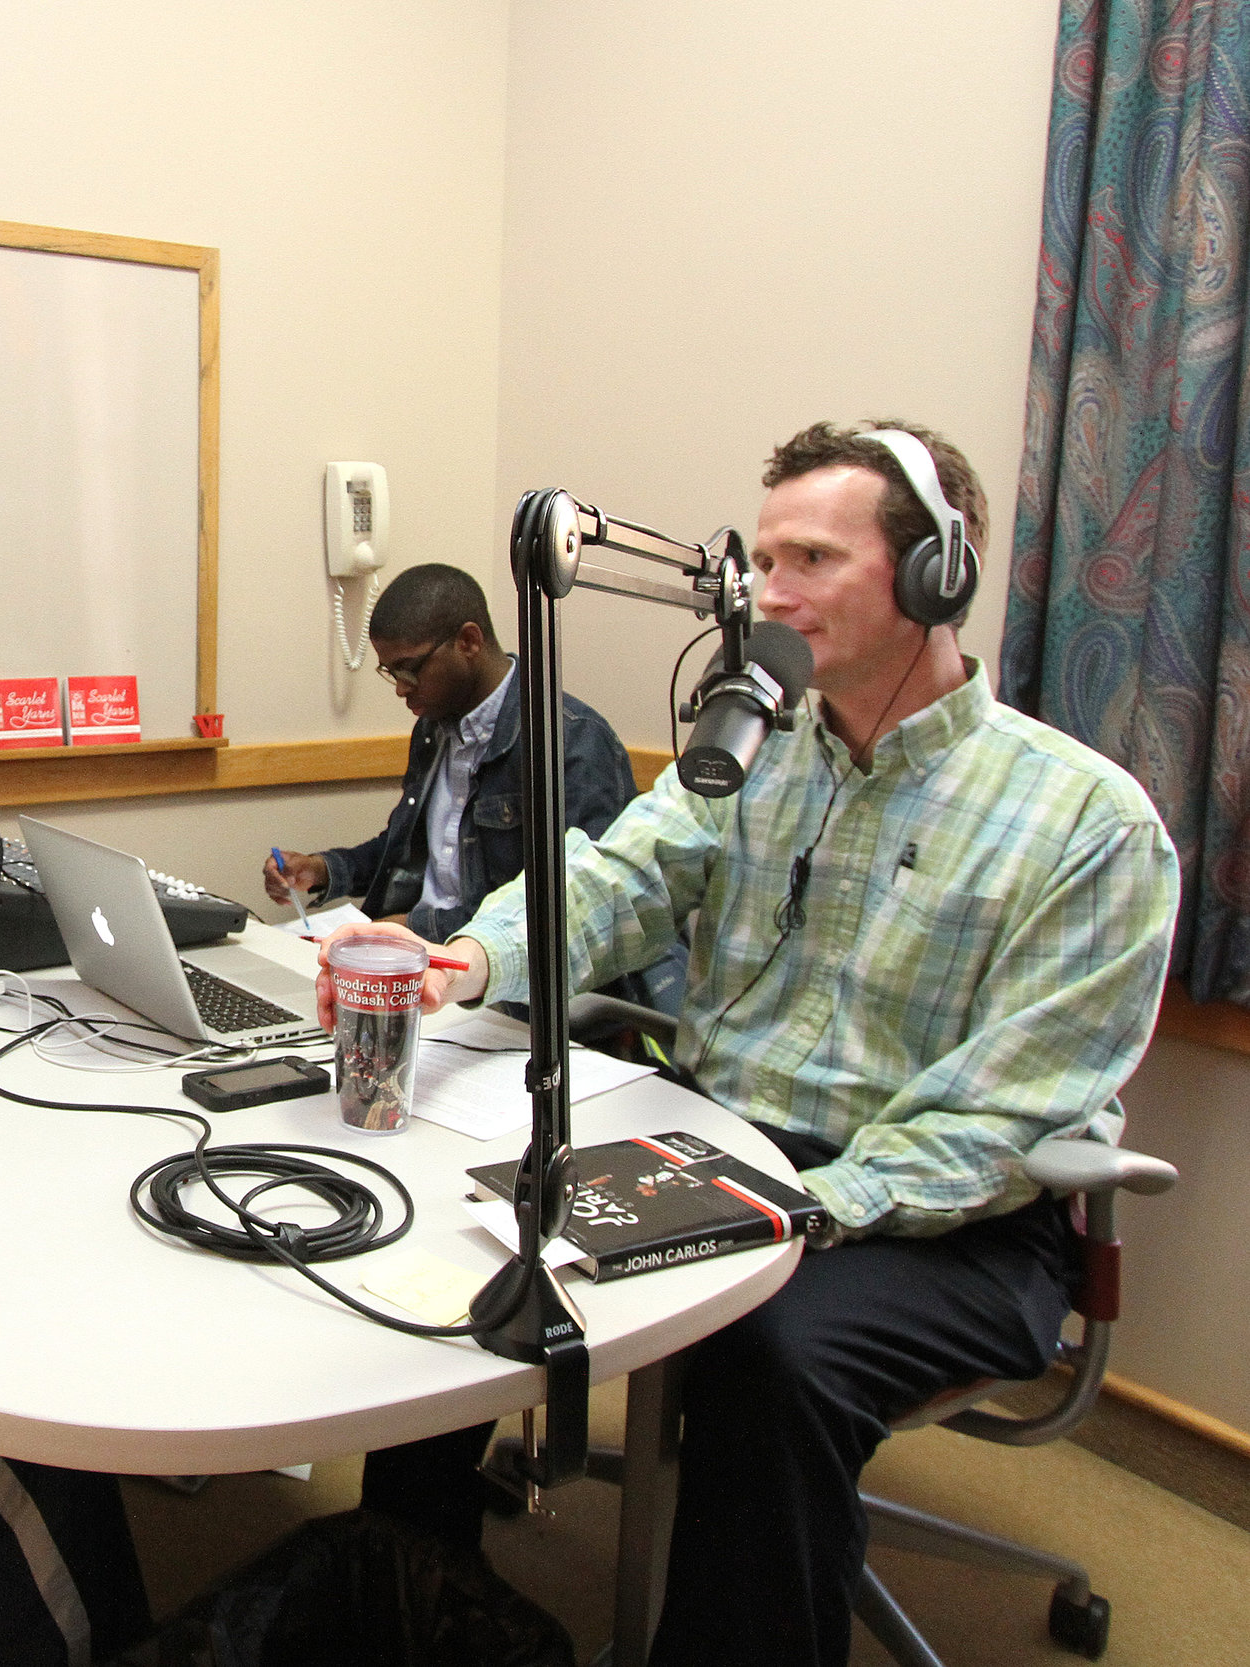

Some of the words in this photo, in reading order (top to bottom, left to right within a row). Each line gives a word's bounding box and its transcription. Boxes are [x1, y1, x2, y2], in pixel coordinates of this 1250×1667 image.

[5, 691, 47, 706] Scarlet
[87, 688, 127, 703] Scarlet
[9, 705, 56, 729] Yarns
[91, 703, 135, 725] Yarns
[333, 973, 388, 993] Goodrich
[336, 986, 386, 1007] Wabash
[624, 1251, 663, 1273] JOHN
[664, 1239, 718, 1263] CARLOS
